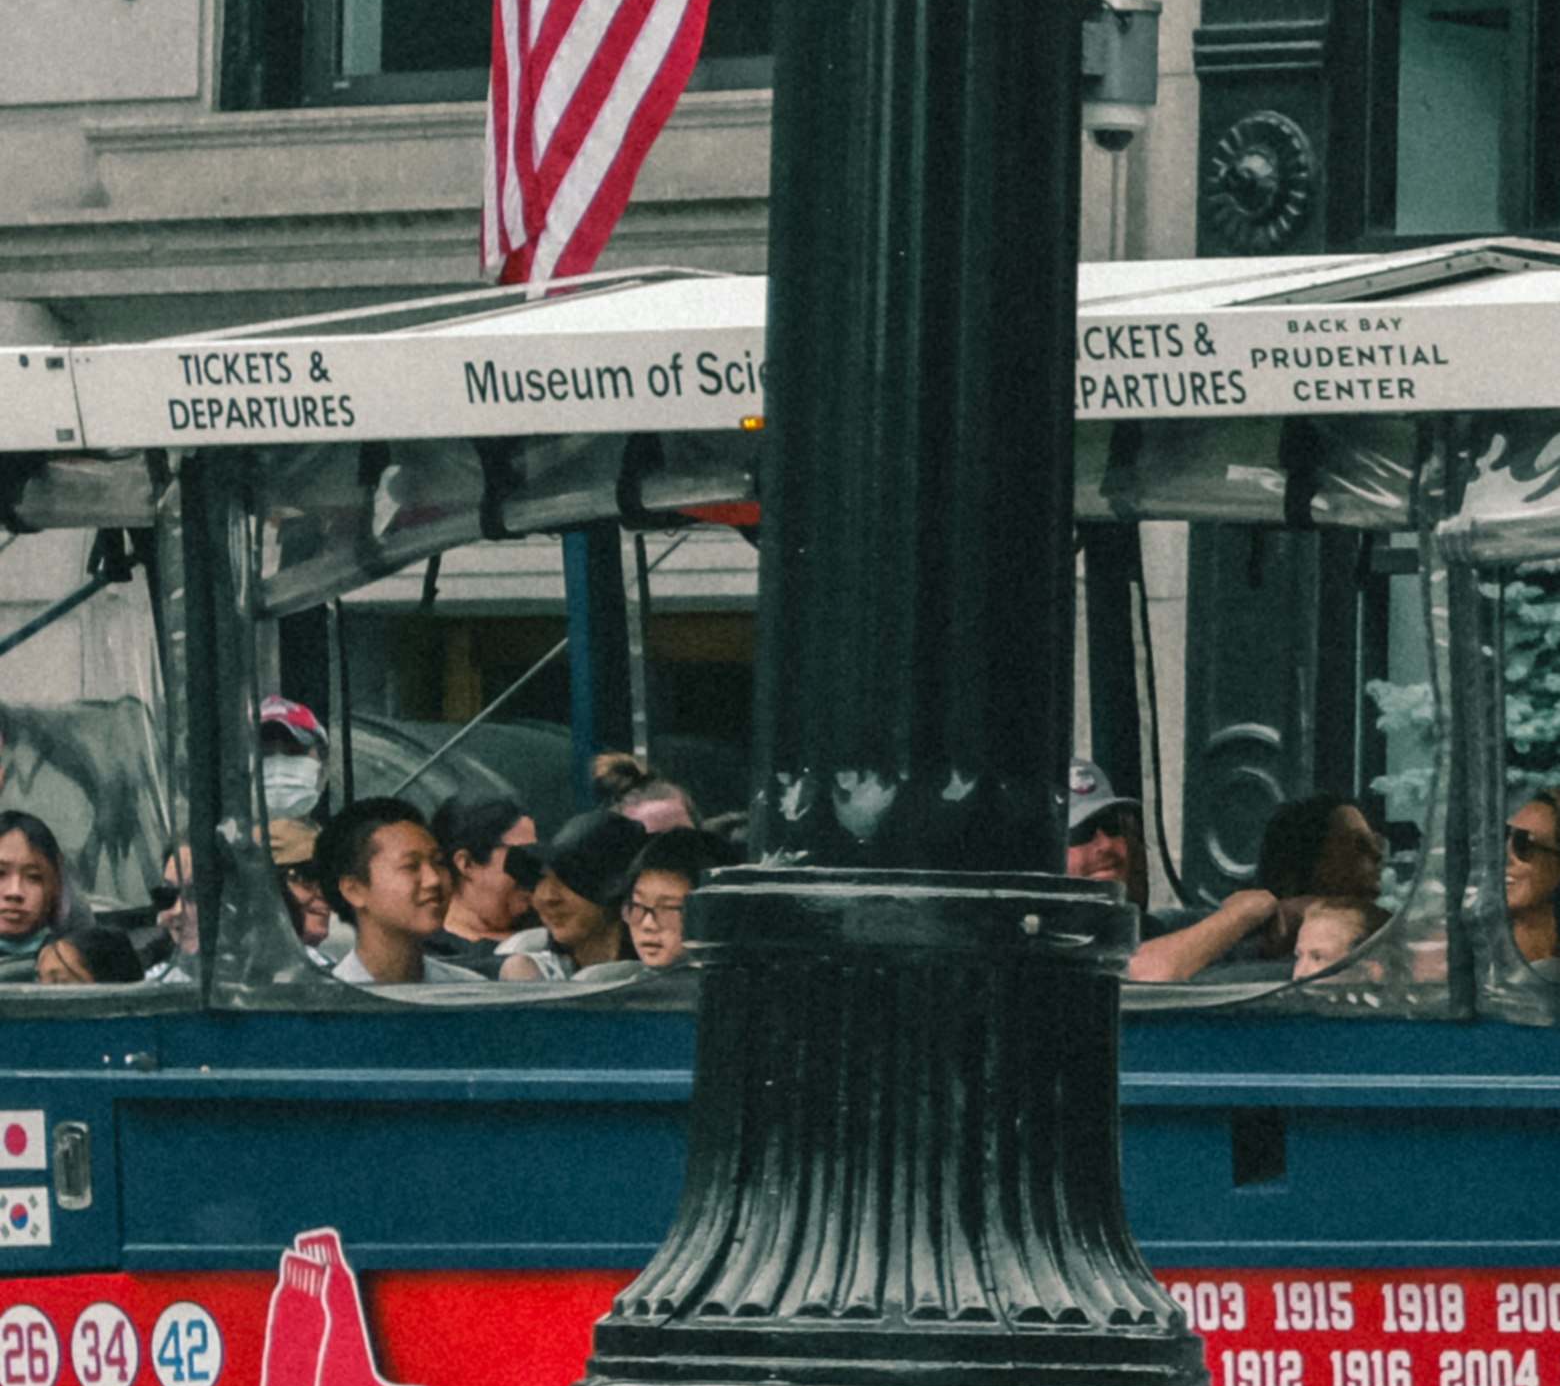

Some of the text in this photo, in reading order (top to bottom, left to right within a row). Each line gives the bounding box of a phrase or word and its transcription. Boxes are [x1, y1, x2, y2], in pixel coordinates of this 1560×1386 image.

[1194, 321, 1217, 357] &
[1287, 317, 1402, 333] BACK BAY
[179, 351, 331, 385] TICKETS &
[1251, 344, 1449, 369] PRUDENTIAL
[464, 360, 634, 404] Museum
[648, 352, 683, 397] of
[1075, 369, 1247, 410] PARTURES
[1293, 377, 1415, 401] CENTER
[169, 395, 356, 431] DEPARTURES
[1162, 1282, 1246, 1332] 903
[1272, 1282, 1354, 1331] 1915
[1381, 1283, 1465, 1332] 1918
[2, 1319, 209, 1384] 26 34 42
